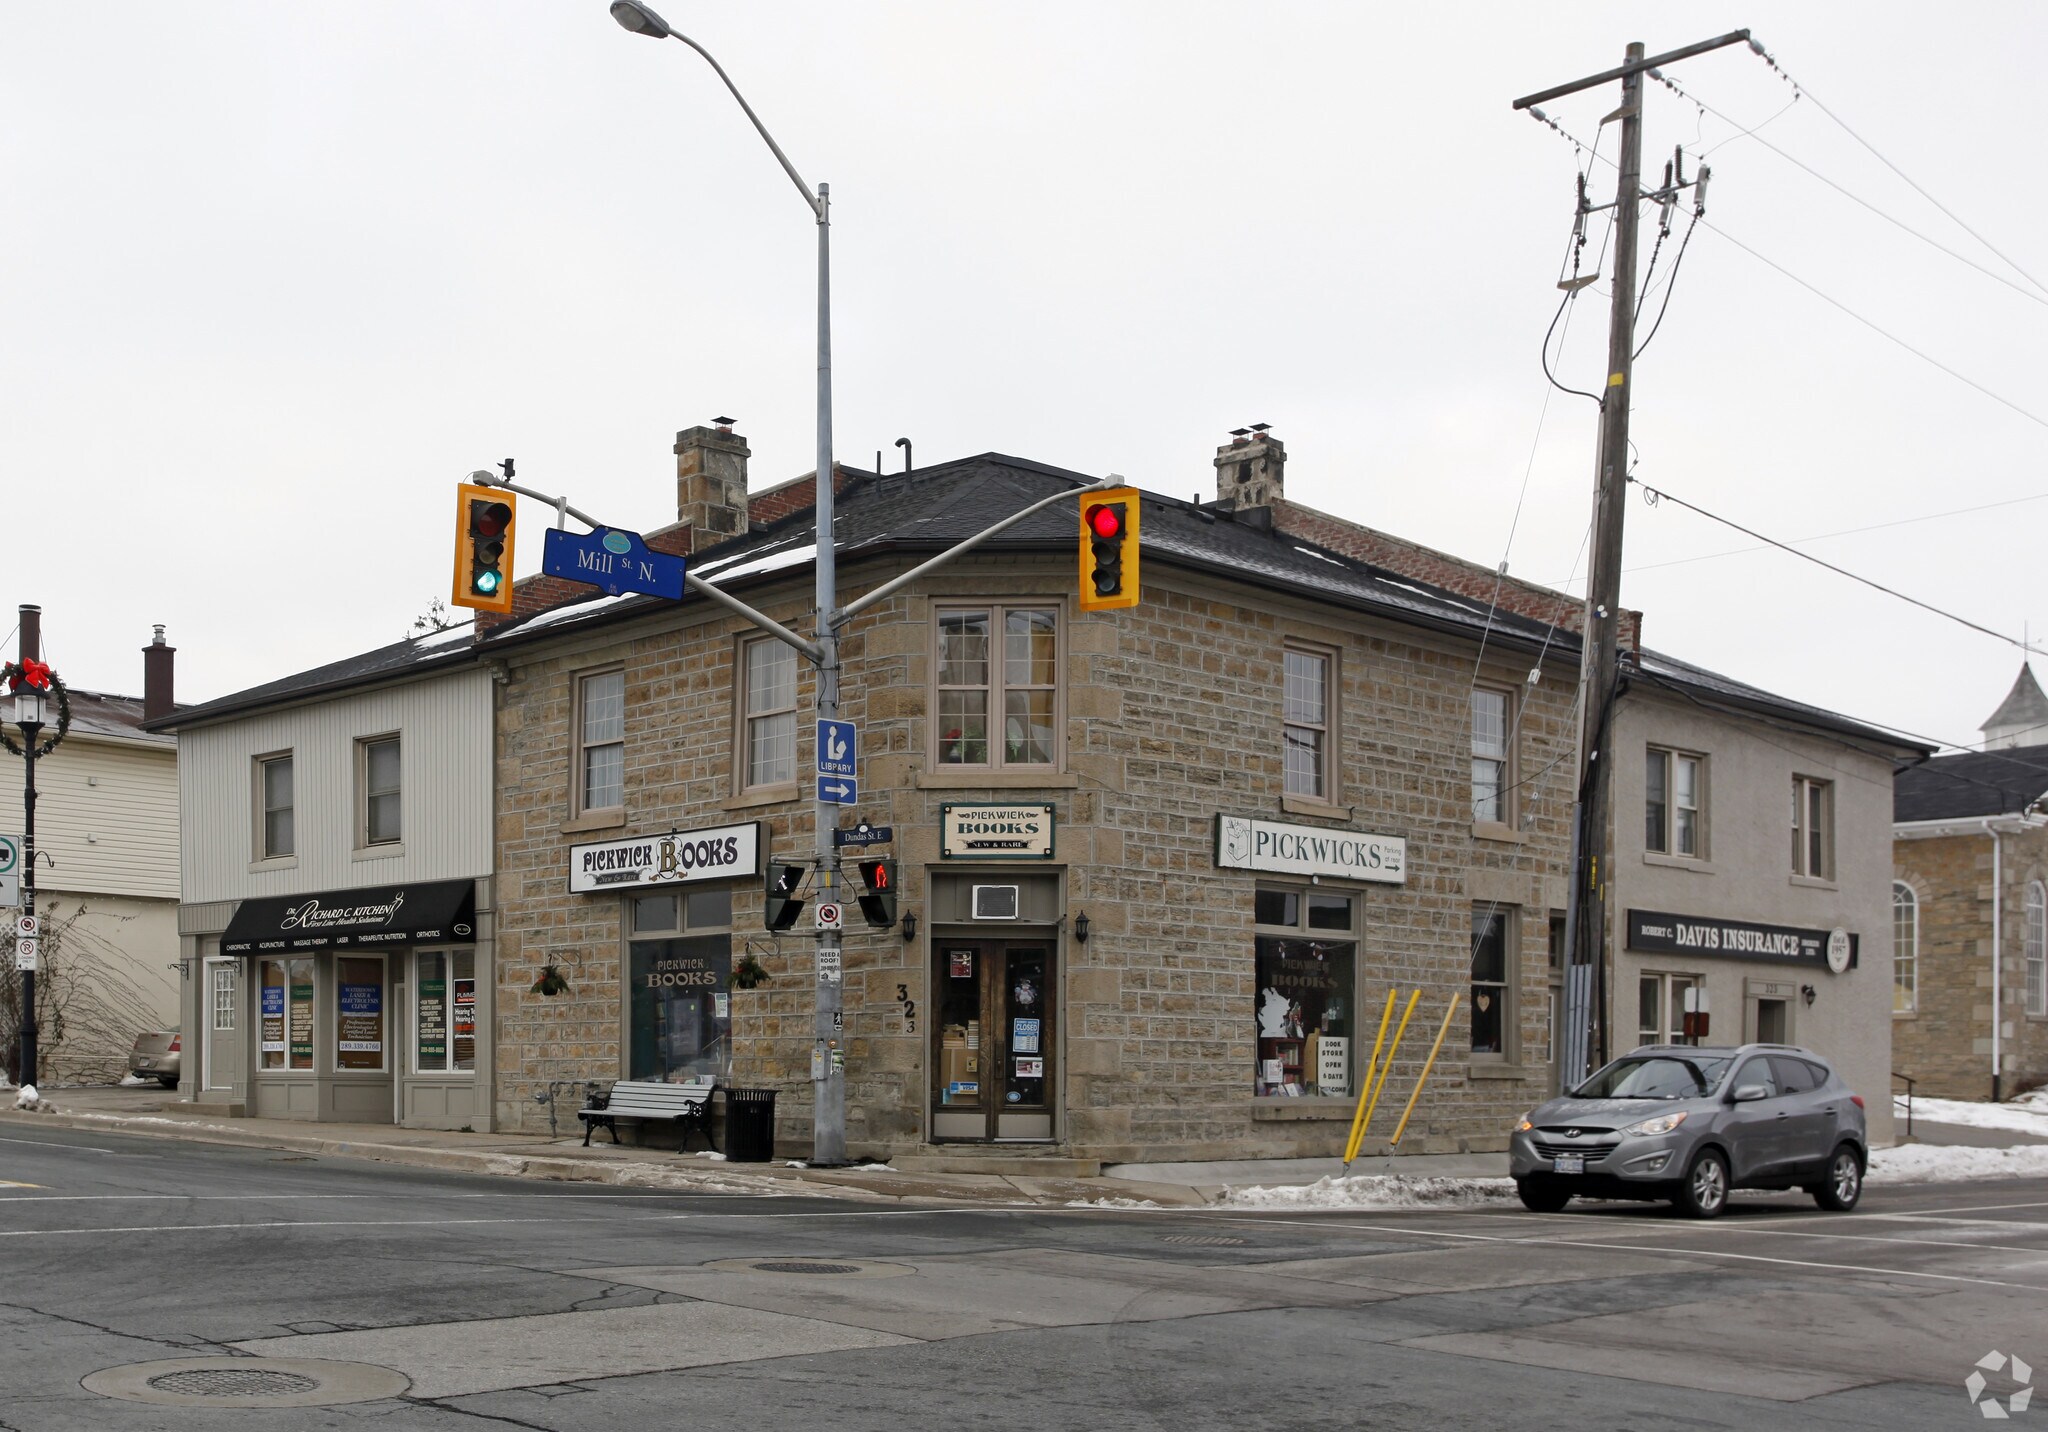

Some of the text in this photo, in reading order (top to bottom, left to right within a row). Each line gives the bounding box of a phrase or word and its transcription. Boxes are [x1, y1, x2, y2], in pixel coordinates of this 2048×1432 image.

[578, 549, 655, 582] Mill St. N.
[821, 762, 851, 772] LIBRARY
[971, 811, 1025, 819] PICKWICK
[958, 823, 1039, 834] BOOKS
[845, 832, 866, 841] Dundas
[583, 837, 737, 872] PICKWICK BOOKS
[1256, 831, 1381, 868] PICKWICKS
[1384, 846, 1401, 856] Parking
[281, 900, 343, 929] RICHARD
[344, 908, 352, 916] C.
[353, 904, 392, 916] KITCHEN
[356, 916, 385, 924] Solutions
[358, 934, 384, 942] THERAPEUTIC
[417, 930, 440, 938] ORTHOTICS
[1642, 924, 1799, 955] ROBERT C. DAVIS INSURANCE
[658, 959, 704, 970] PICKWICK
[1282, 960, 1330, 971] PICKWICK
[646, 971, 717, 988] BOOKS
[1272, 975, 1338, 988] BOOKS
[455, 1008, 470, 1016] Hearing
[1016, 1024, 1038, 1032] CLOSED
